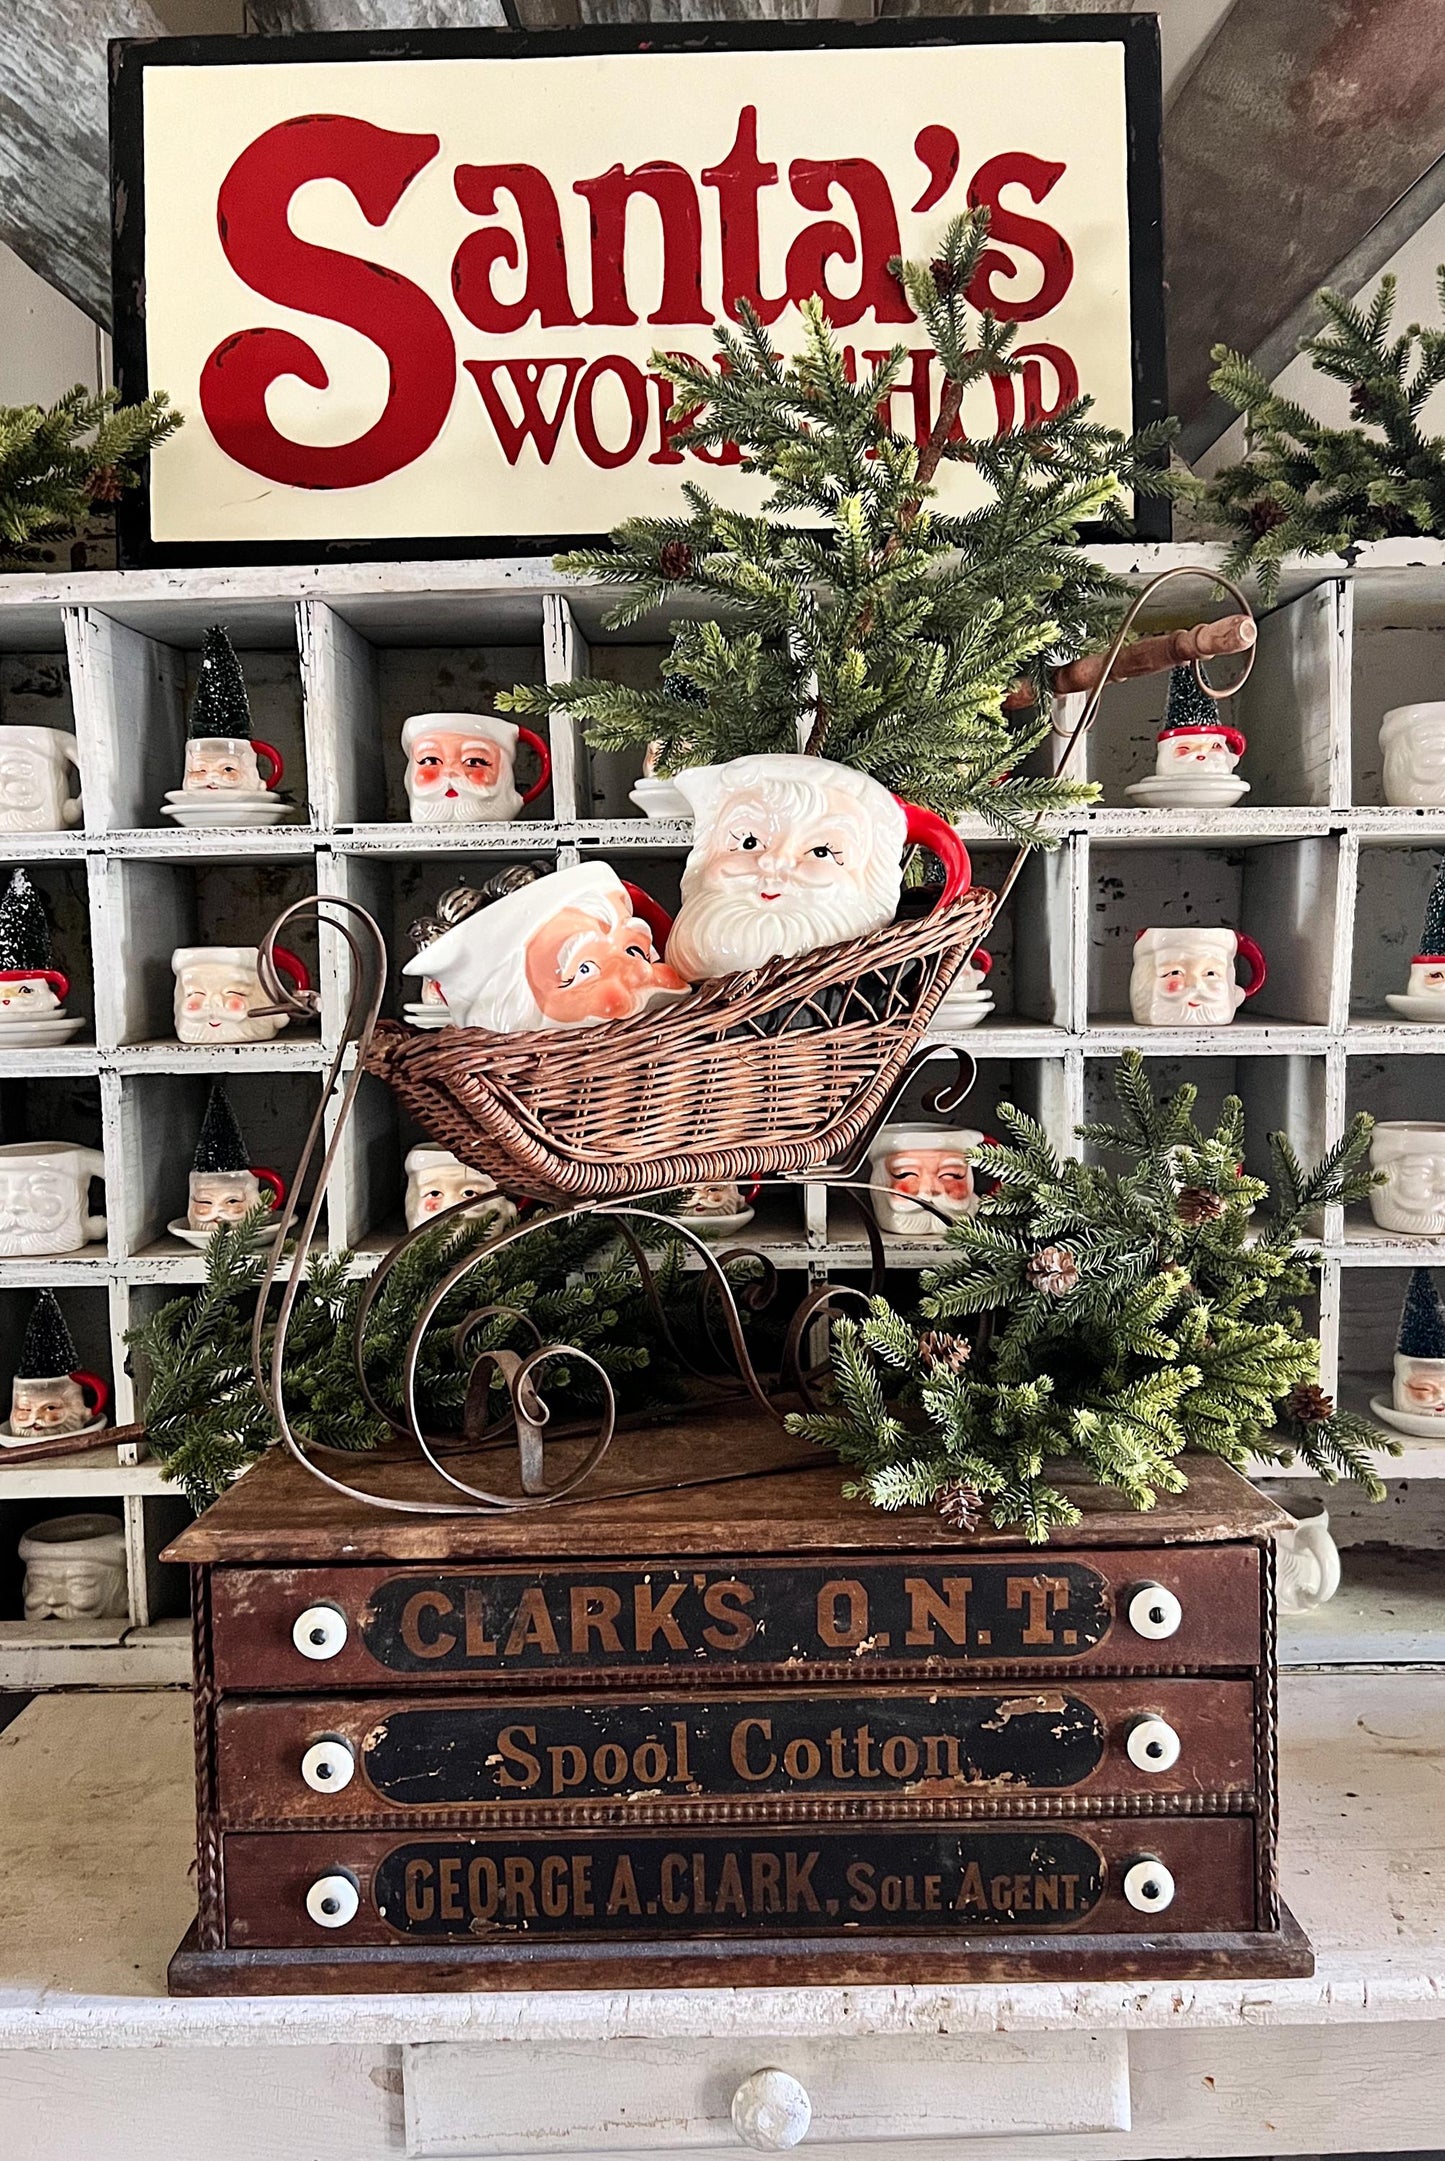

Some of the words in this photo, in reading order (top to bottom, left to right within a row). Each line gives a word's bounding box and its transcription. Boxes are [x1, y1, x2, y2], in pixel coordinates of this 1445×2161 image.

[200, 104, 1074, 489] Santa's
[463, 343, 1080, 469] WORHOP
[400, 1573, 756, 1659] CLARK'S
[496, 1720, 695, 1794] Spool
[730, 1717, 961, 1781] Cotton
[405, 1856, 594, 1921] GEORGE
